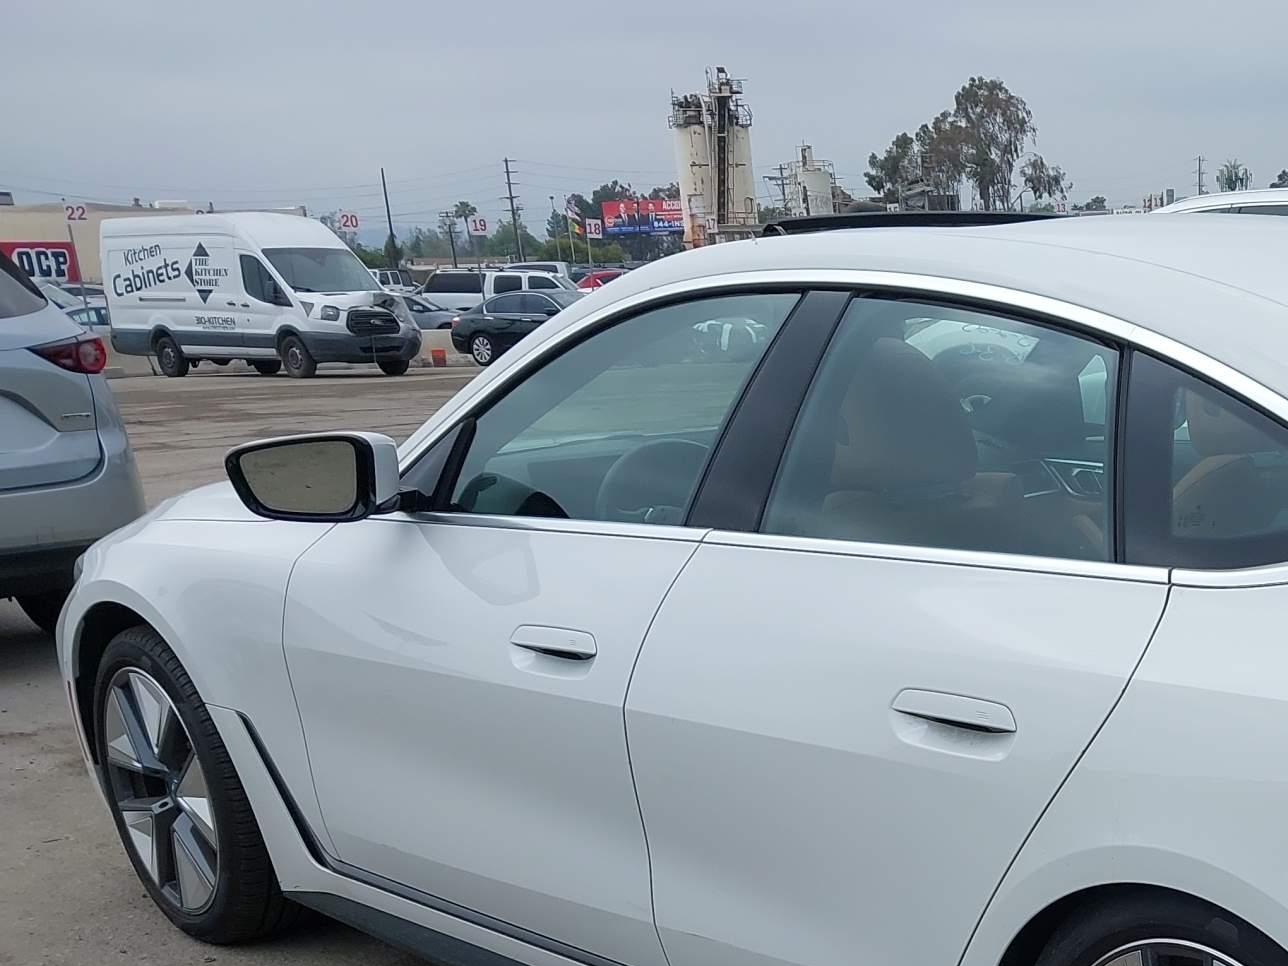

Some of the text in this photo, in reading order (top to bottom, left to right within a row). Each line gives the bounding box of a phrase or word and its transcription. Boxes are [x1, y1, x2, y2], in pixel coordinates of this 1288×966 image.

[65, 205, 88, 221] 22
[1056, 203, 1066, 213] 13
[341, 214, 359, 228] 20
[472, 218, 487, 232] 19
[705, 218, 716, 231] 17
[587, 222, 601, 236] 18
[123, 243, 162, 267] Kitchen
[194, 258, 209, 267] THE
[112, 257, 182, 297] Cabinets
[194, 268, 229, 277] KITCHEN
[194, 278, 219, 288] STORE
